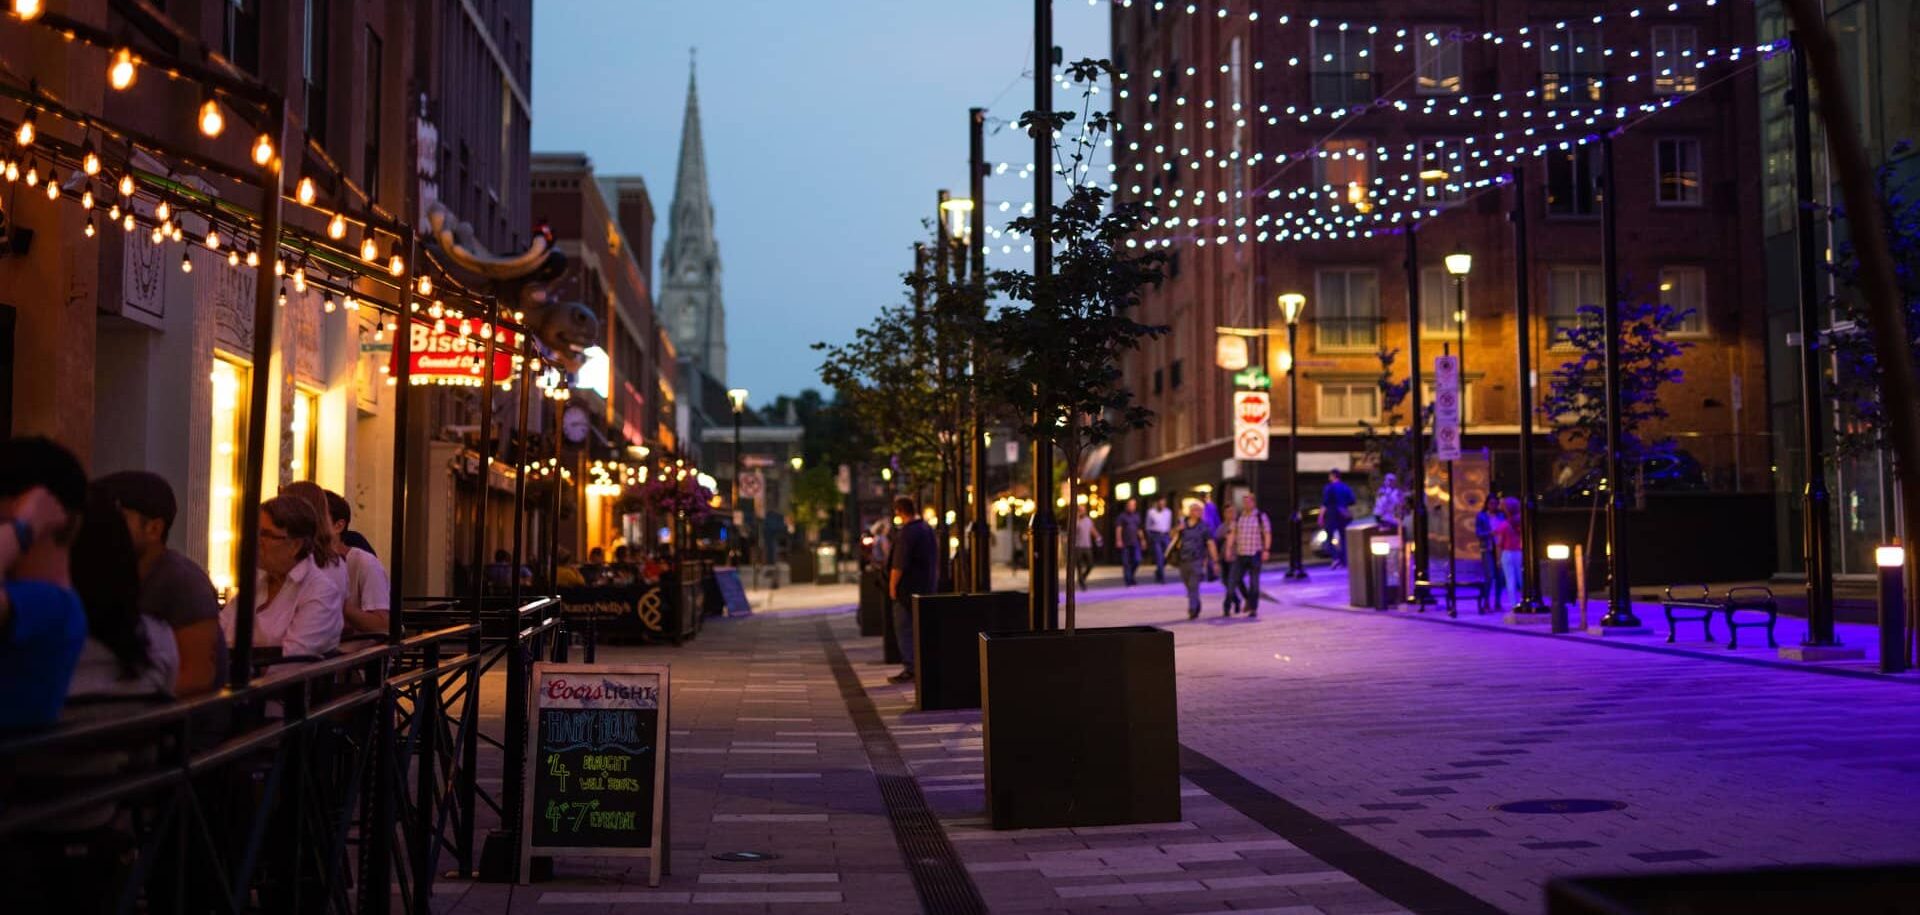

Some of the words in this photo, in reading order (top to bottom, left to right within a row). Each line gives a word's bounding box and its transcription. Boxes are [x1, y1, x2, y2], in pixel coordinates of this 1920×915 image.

[1239, 403, 1266, 416] STOP
[548, 679, 603, 700] Coors
[604, 686, 653, 700] LIGHT
[548, 711, 597, 743] HAPPY
[598, 711, 640, 744] HOUR
